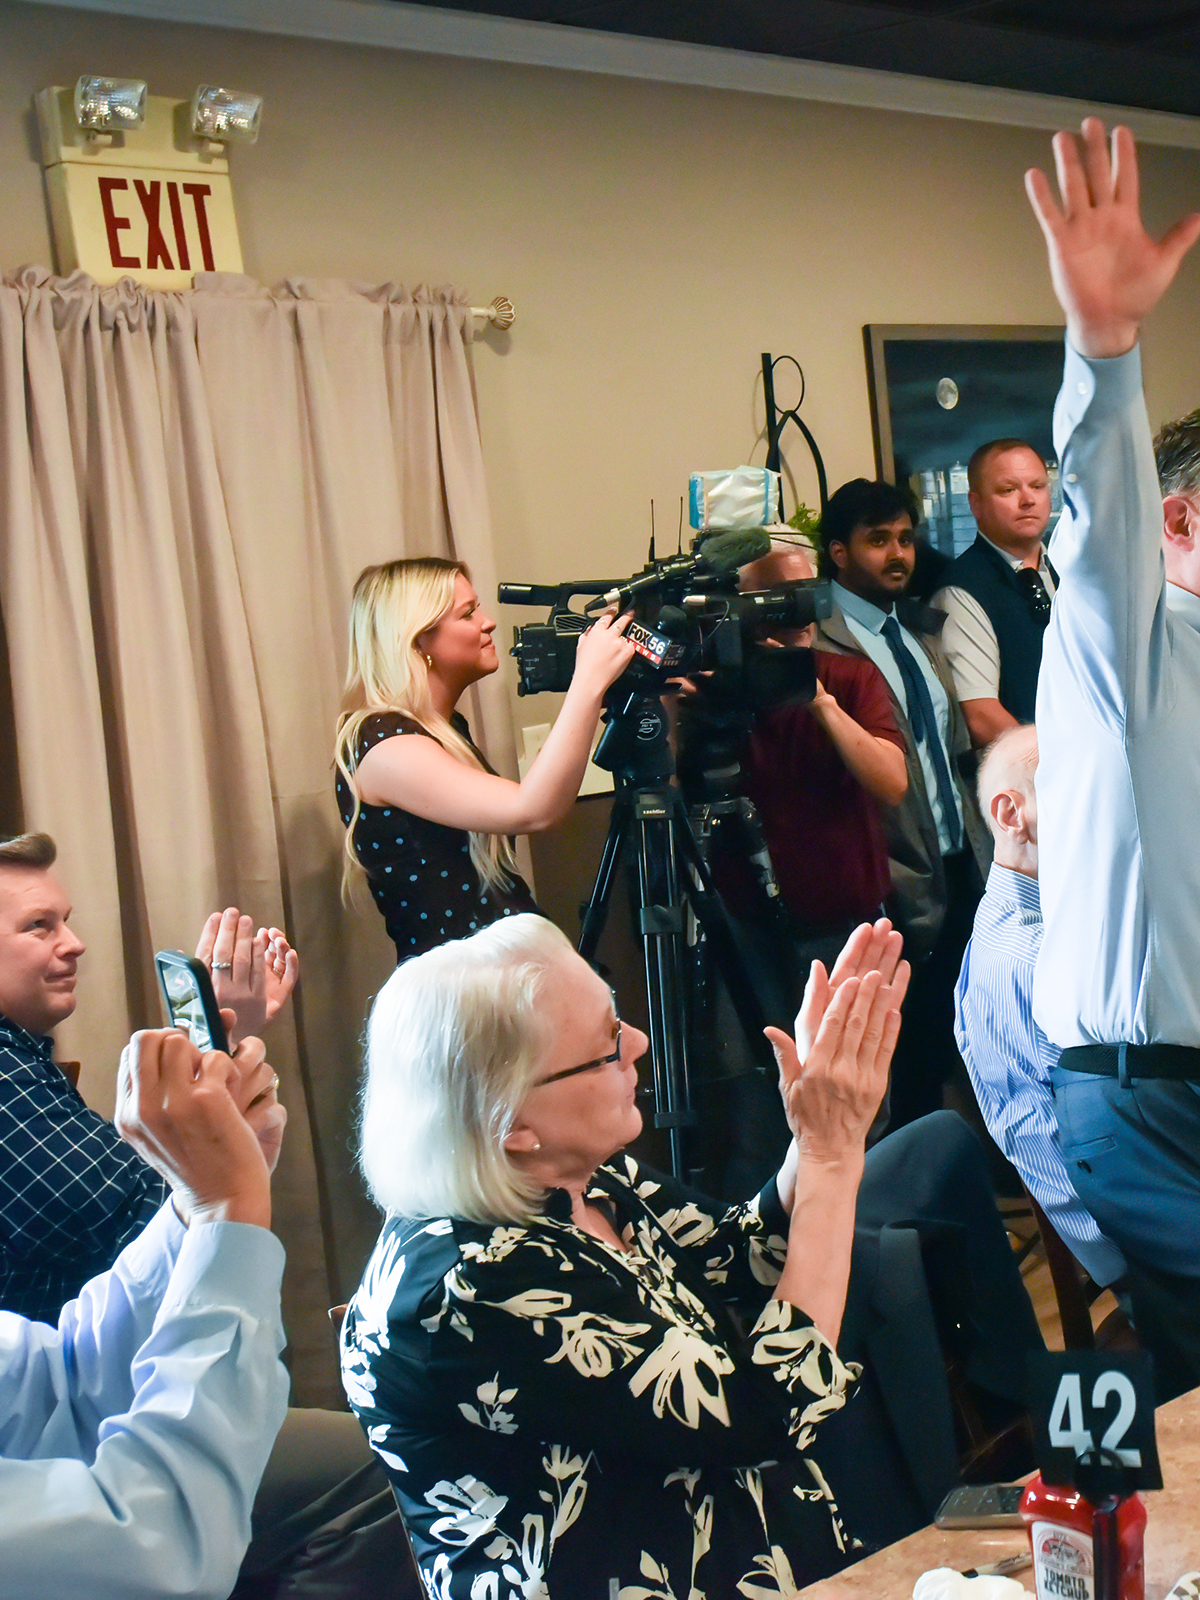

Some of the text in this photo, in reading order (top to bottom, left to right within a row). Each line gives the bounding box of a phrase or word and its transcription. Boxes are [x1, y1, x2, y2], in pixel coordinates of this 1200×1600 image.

[98, 176, 215, 272] EXIT
[627, 623, 666, 655] FOX 56
[1048, 1369, 1142, 1468] 42
[1044, 1567, 1086, 1589] TOMATO
[1044, 1580, 1090, 1600] KETCHUP
